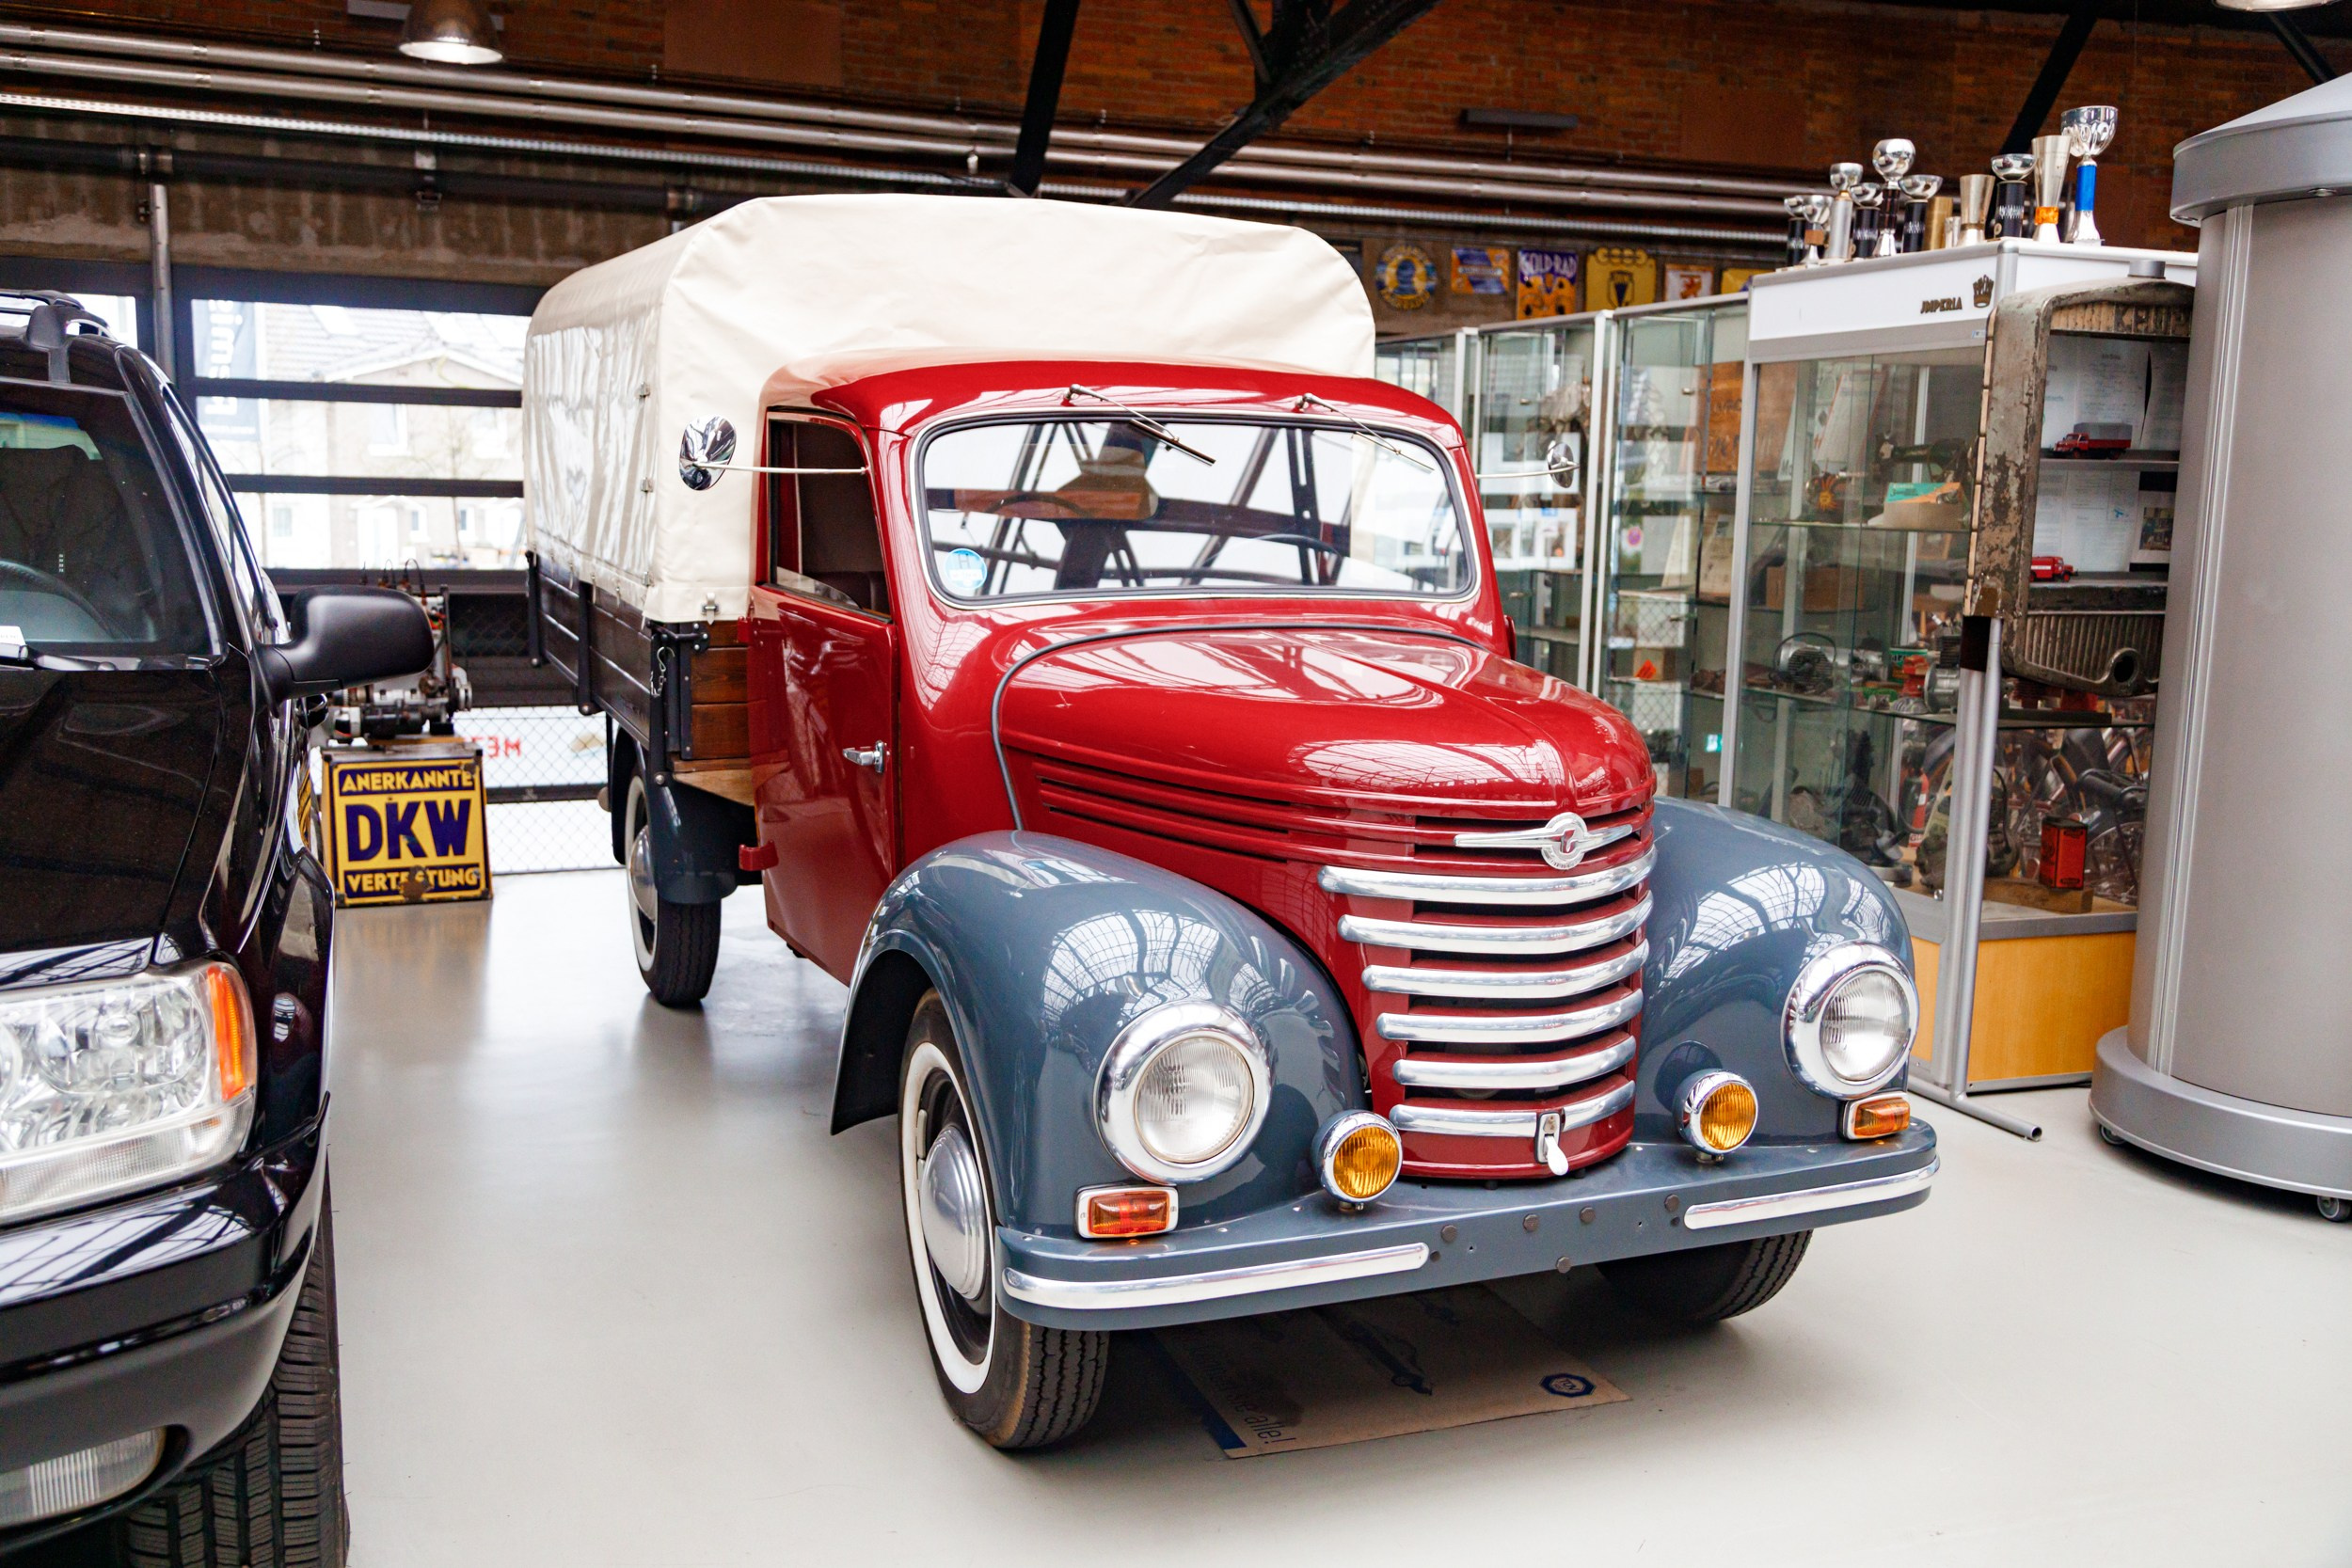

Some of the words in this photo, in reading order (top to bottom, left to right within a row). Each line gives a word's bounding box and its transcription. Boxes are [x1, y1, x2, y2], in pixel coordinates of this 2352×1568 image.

[341, 768, 474, 793] ANERKANNTE
[344, 799, 471, 863] DKW
[1244, 1415, 1297, 1444] alle!
